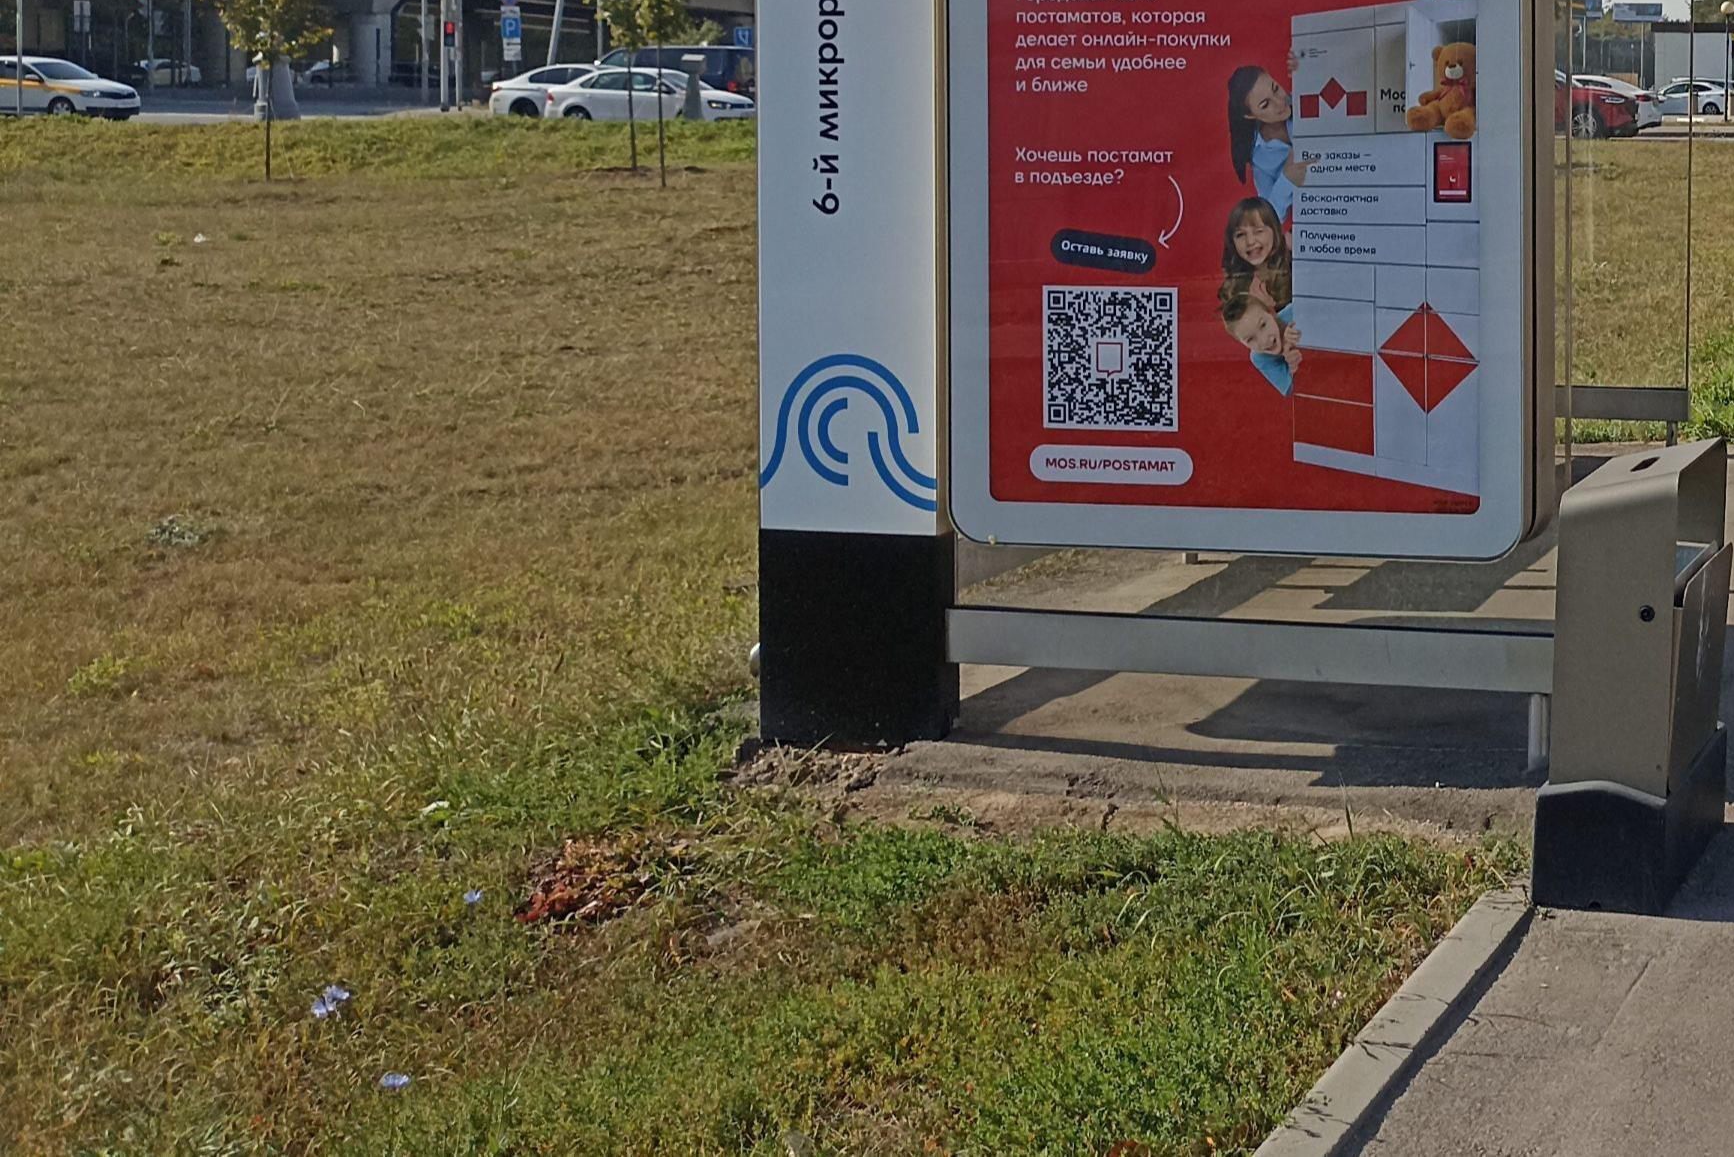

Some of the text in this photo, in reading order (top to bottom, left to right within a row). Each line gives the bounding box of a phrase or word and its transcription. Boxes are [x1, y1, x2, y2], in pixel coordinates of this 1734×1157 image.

[1016, 10, 1206, 26] постаматов, которая
[1015, 31, 1231, 50] делает онлайн-покупки
[1015, 54, 1187, 73] для семьи удобнее
[1016, 76, 1088, 92] и ближе
[1015, 146, 1173, 163] Хочешь постамат
[1325, 151, 1361, 160] заказы
[1014, 168, 1125, 186] в подъезде?
[1310, 164, 1376, 174] одном месте
[812, 154, 840, 215] 6-й
[1300, 192, 1379, 203] Бесконтактная
[1300, 207, 1348, 216] доставка
[1300, 229, 1356, 242] Получение
[1060, 239, 1148, 263] Оставь заявку
[1344, 246, 1377, 256] время
[1044, 457, 1177, 473] MOS.RU/POSTAMAT
